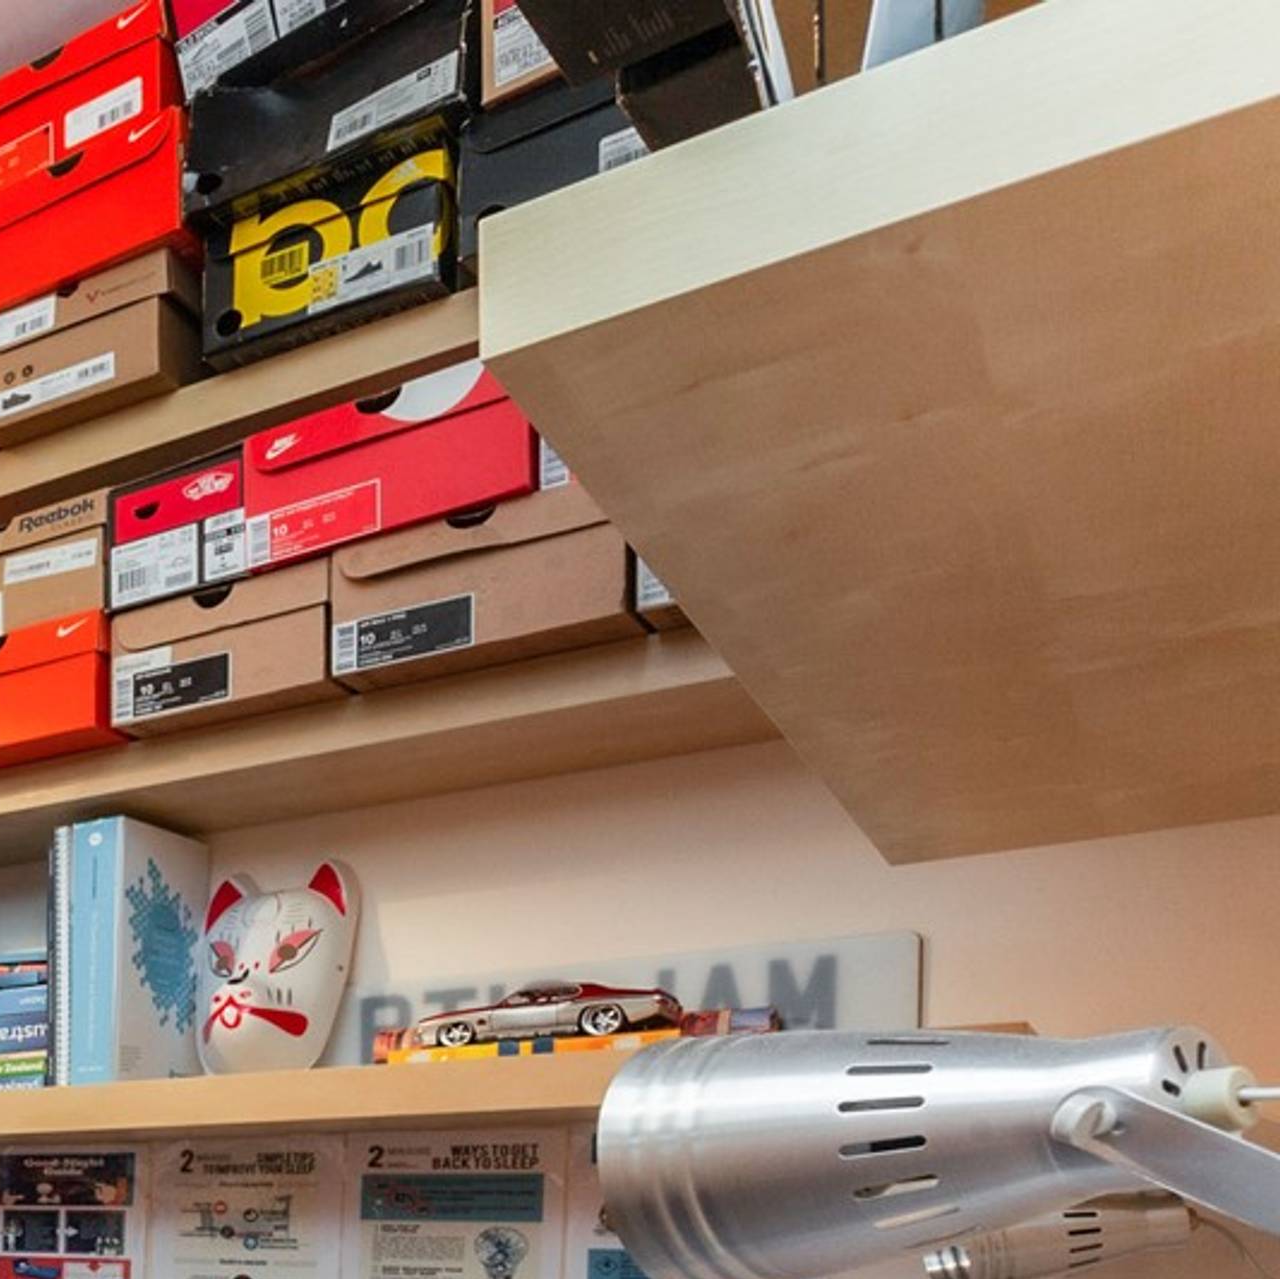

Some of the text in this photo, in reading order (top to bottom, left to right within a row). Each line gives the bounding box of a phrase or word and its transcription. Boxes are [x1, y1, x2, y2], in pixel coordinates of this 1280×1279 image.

[17, 498, 95, 533] Reebok
[272, 524, 289, 538] 10
[359, 633, 376, 647] 10
[366, 1144, 385, 1169] 2
[450, 1143, 540, 1157] WAYS TO GET
[179, 1149, 195, 1173] 2
[431, 1156, 471, 1171] BACK
[473, 1156, 493, 1170] TO
[495, 1156, 540, 1170] SLEEP
